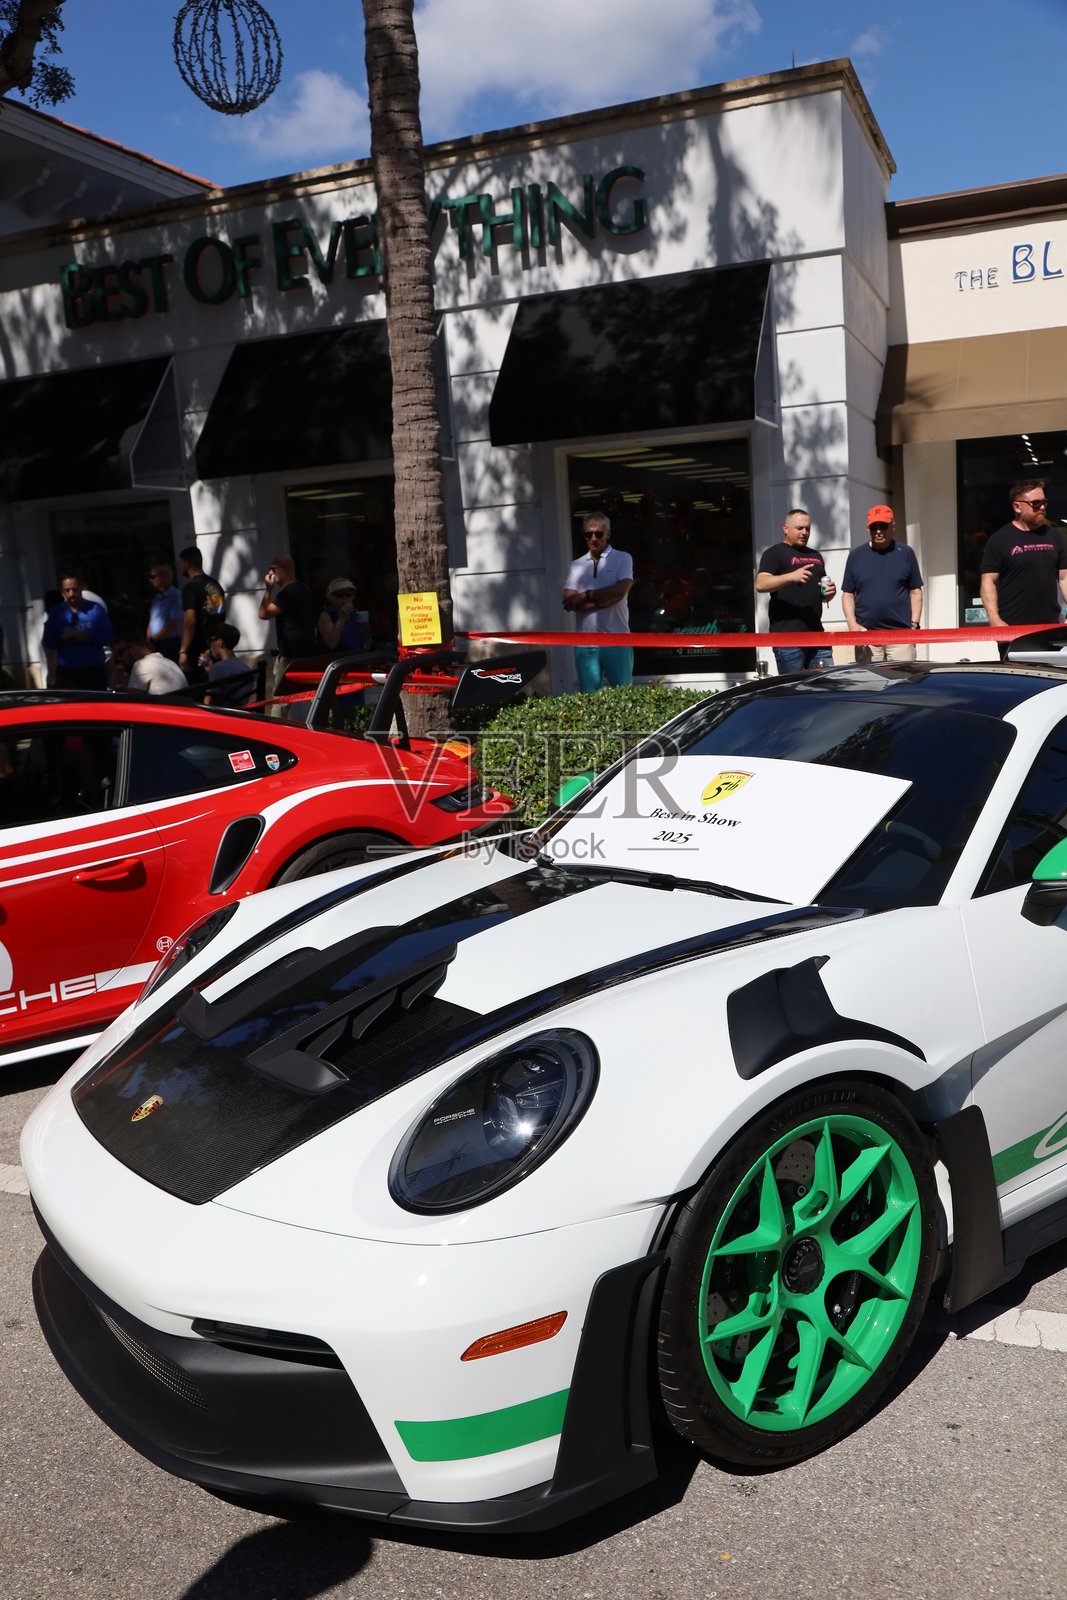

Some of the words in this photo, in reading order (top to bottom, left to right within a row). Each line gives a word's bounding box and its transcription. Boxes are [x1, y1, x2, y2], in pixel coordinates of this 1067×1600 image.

[60, 253, 174, 329] BEST
[184, 235, 261, 305] OF
[271, 165, 646, 291] EVETHING
[954, 266, 998, 290] THE
[703, 779, 742, 801] 5th
[649, 808, 679, 819] Best
[680, 811, 697, 821] in
[697, 812, 742, 828] Show
[652, 830, 694, 845] 2025
